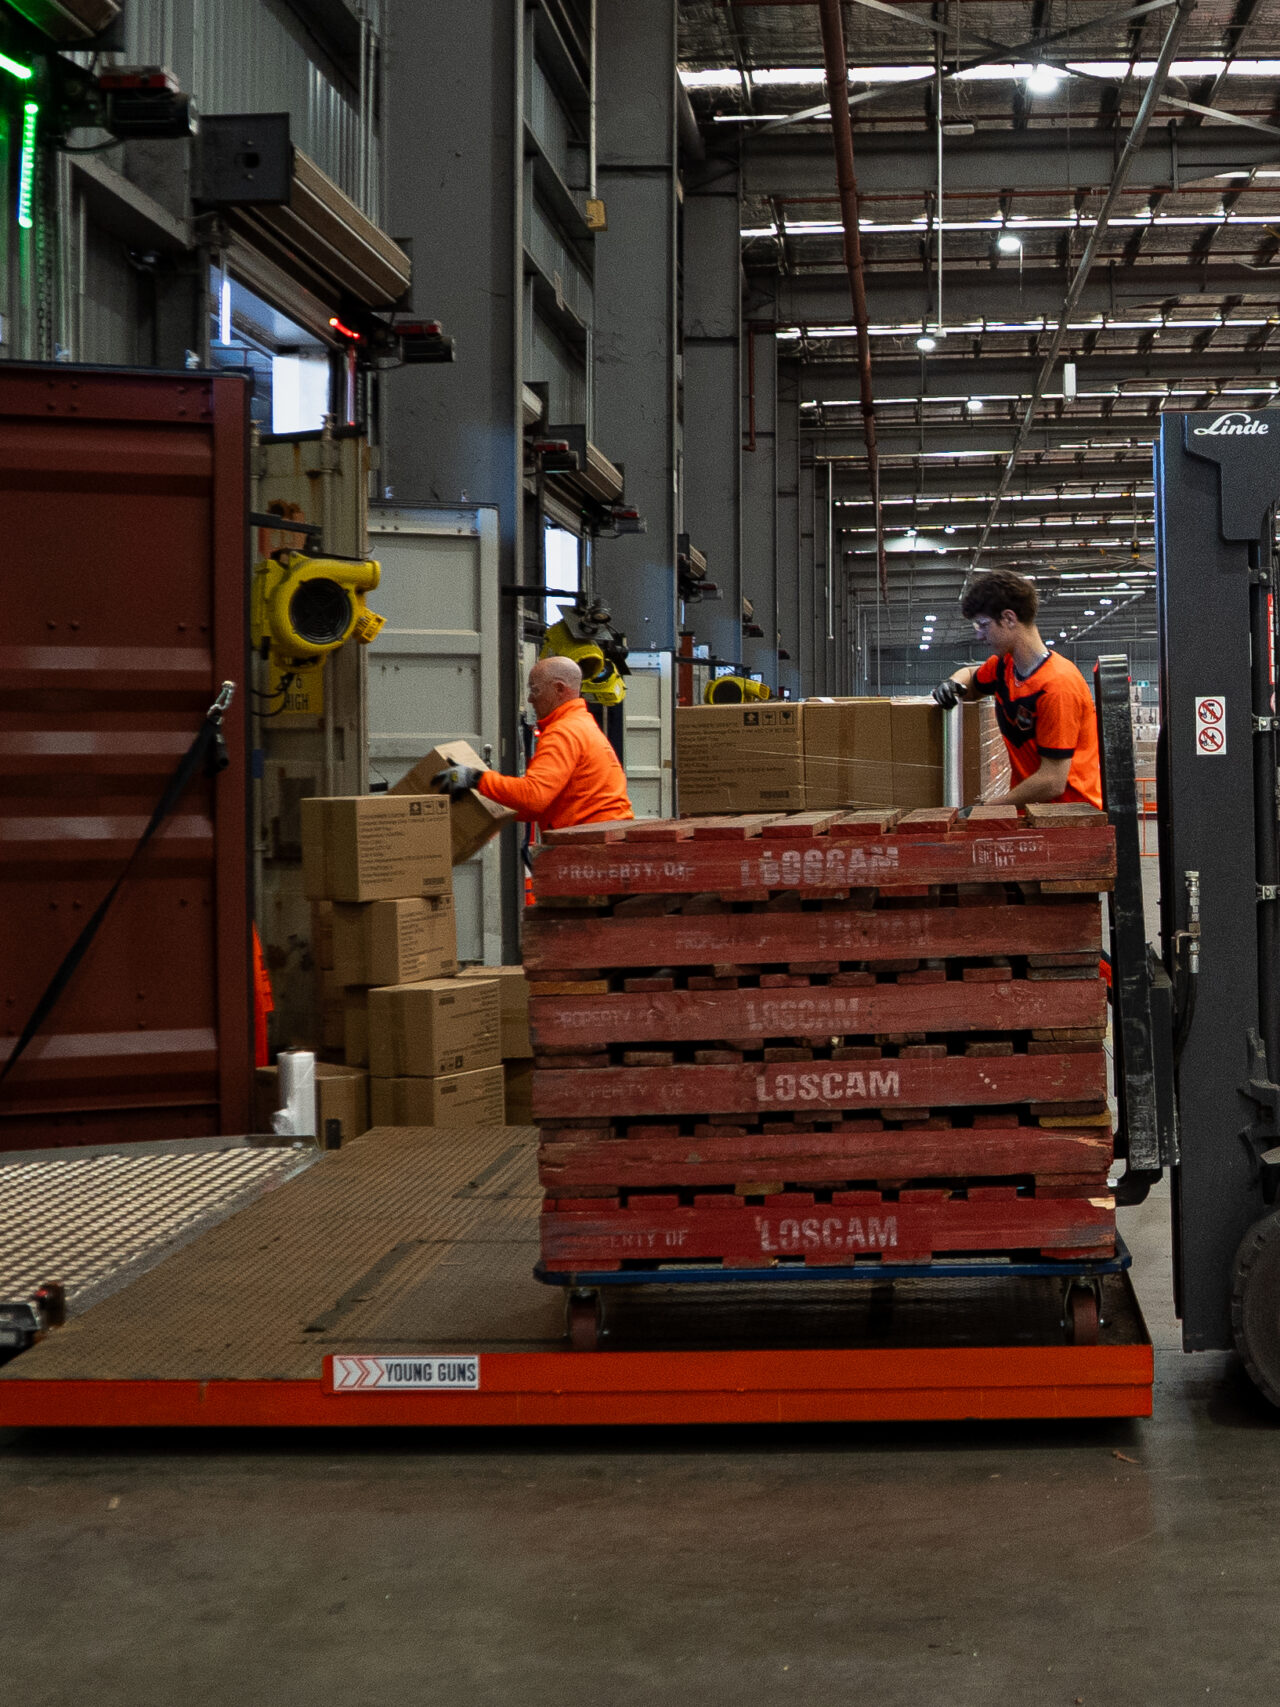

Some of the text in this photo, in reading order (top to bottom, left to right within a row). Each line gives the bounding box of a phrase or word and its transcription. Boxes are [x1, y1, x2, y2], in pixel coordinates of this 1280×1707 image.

[1193, 412, 1269, 436] Linde
[756, 1070, 899, 1102] LOSCAM
[757, 1216, 898, 1251] LOSCAM
[385, 1363, 476, 1382] YOUNG GUNS
